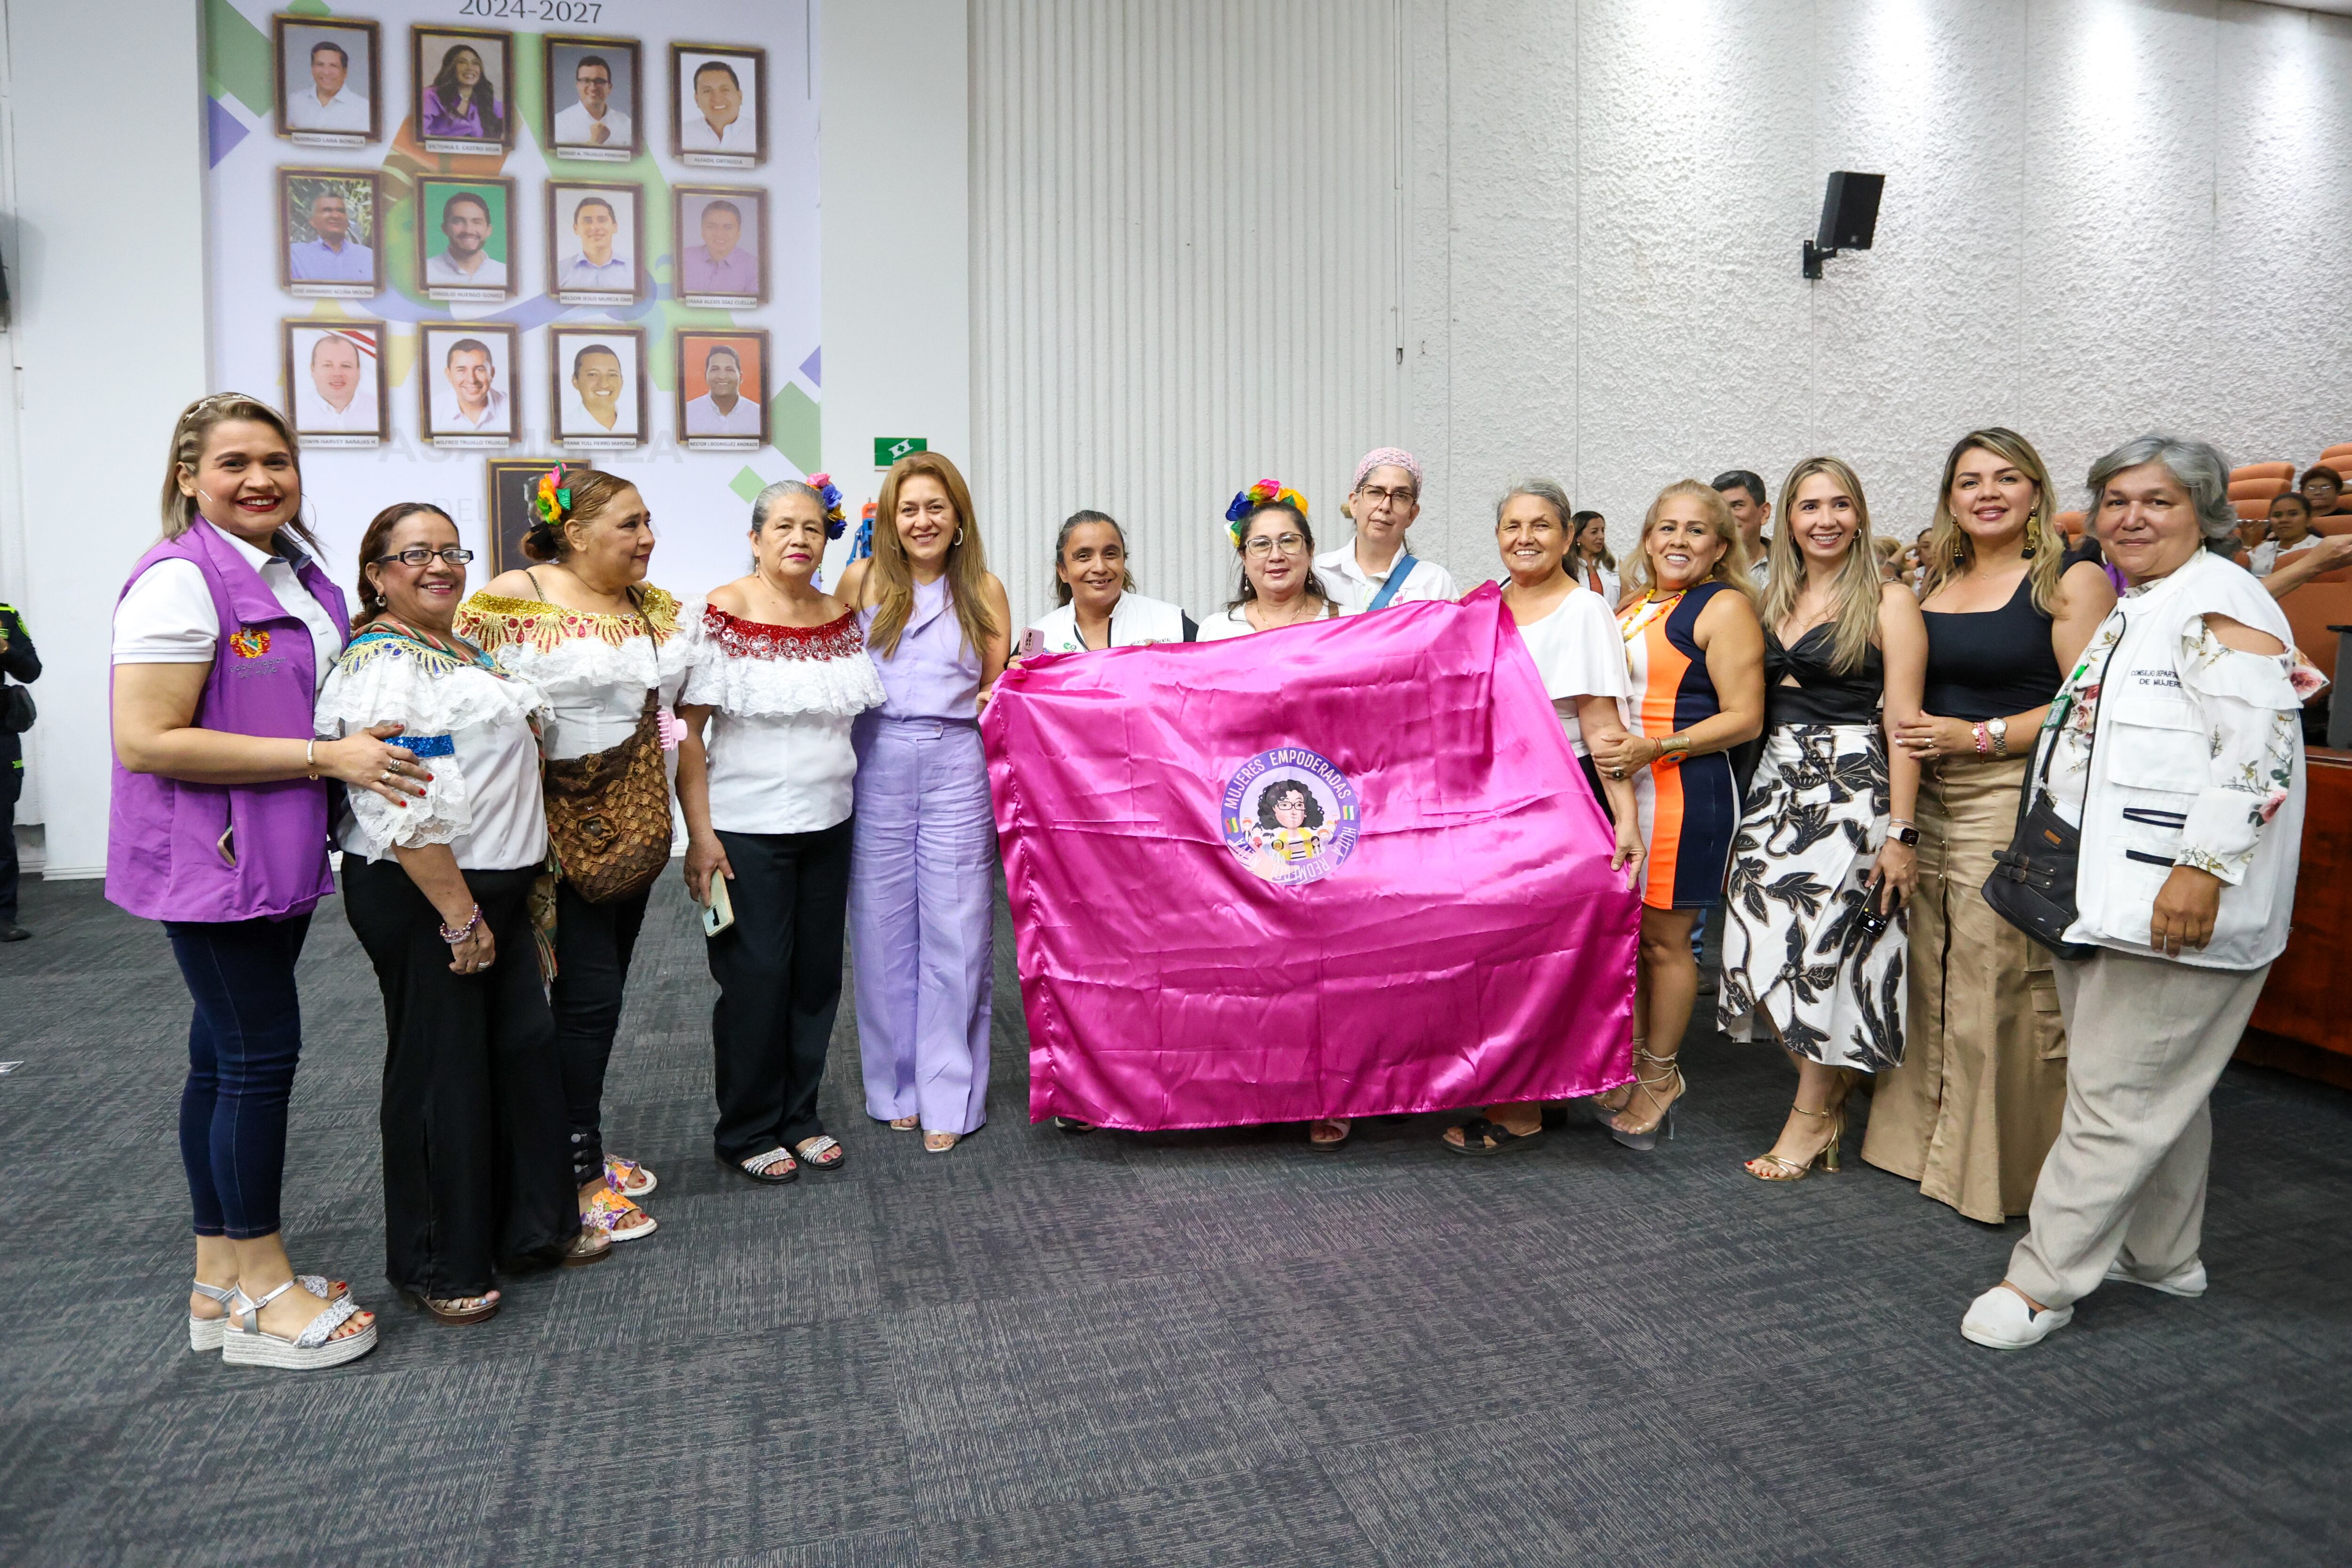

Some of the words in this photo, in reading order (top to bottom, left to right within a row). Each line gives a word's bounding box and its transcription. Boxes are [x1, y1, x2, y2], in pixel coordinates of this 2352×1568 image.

[459, 0, 602, 24] 2024-2027
[2153, 679, 2183, 688] MUJERE
[1224, 758, 1265, 810] MUJERES
[1269, 749, 1351, 799] EMPODERADAS
[1331, 826, 1357, 857] HUILA
